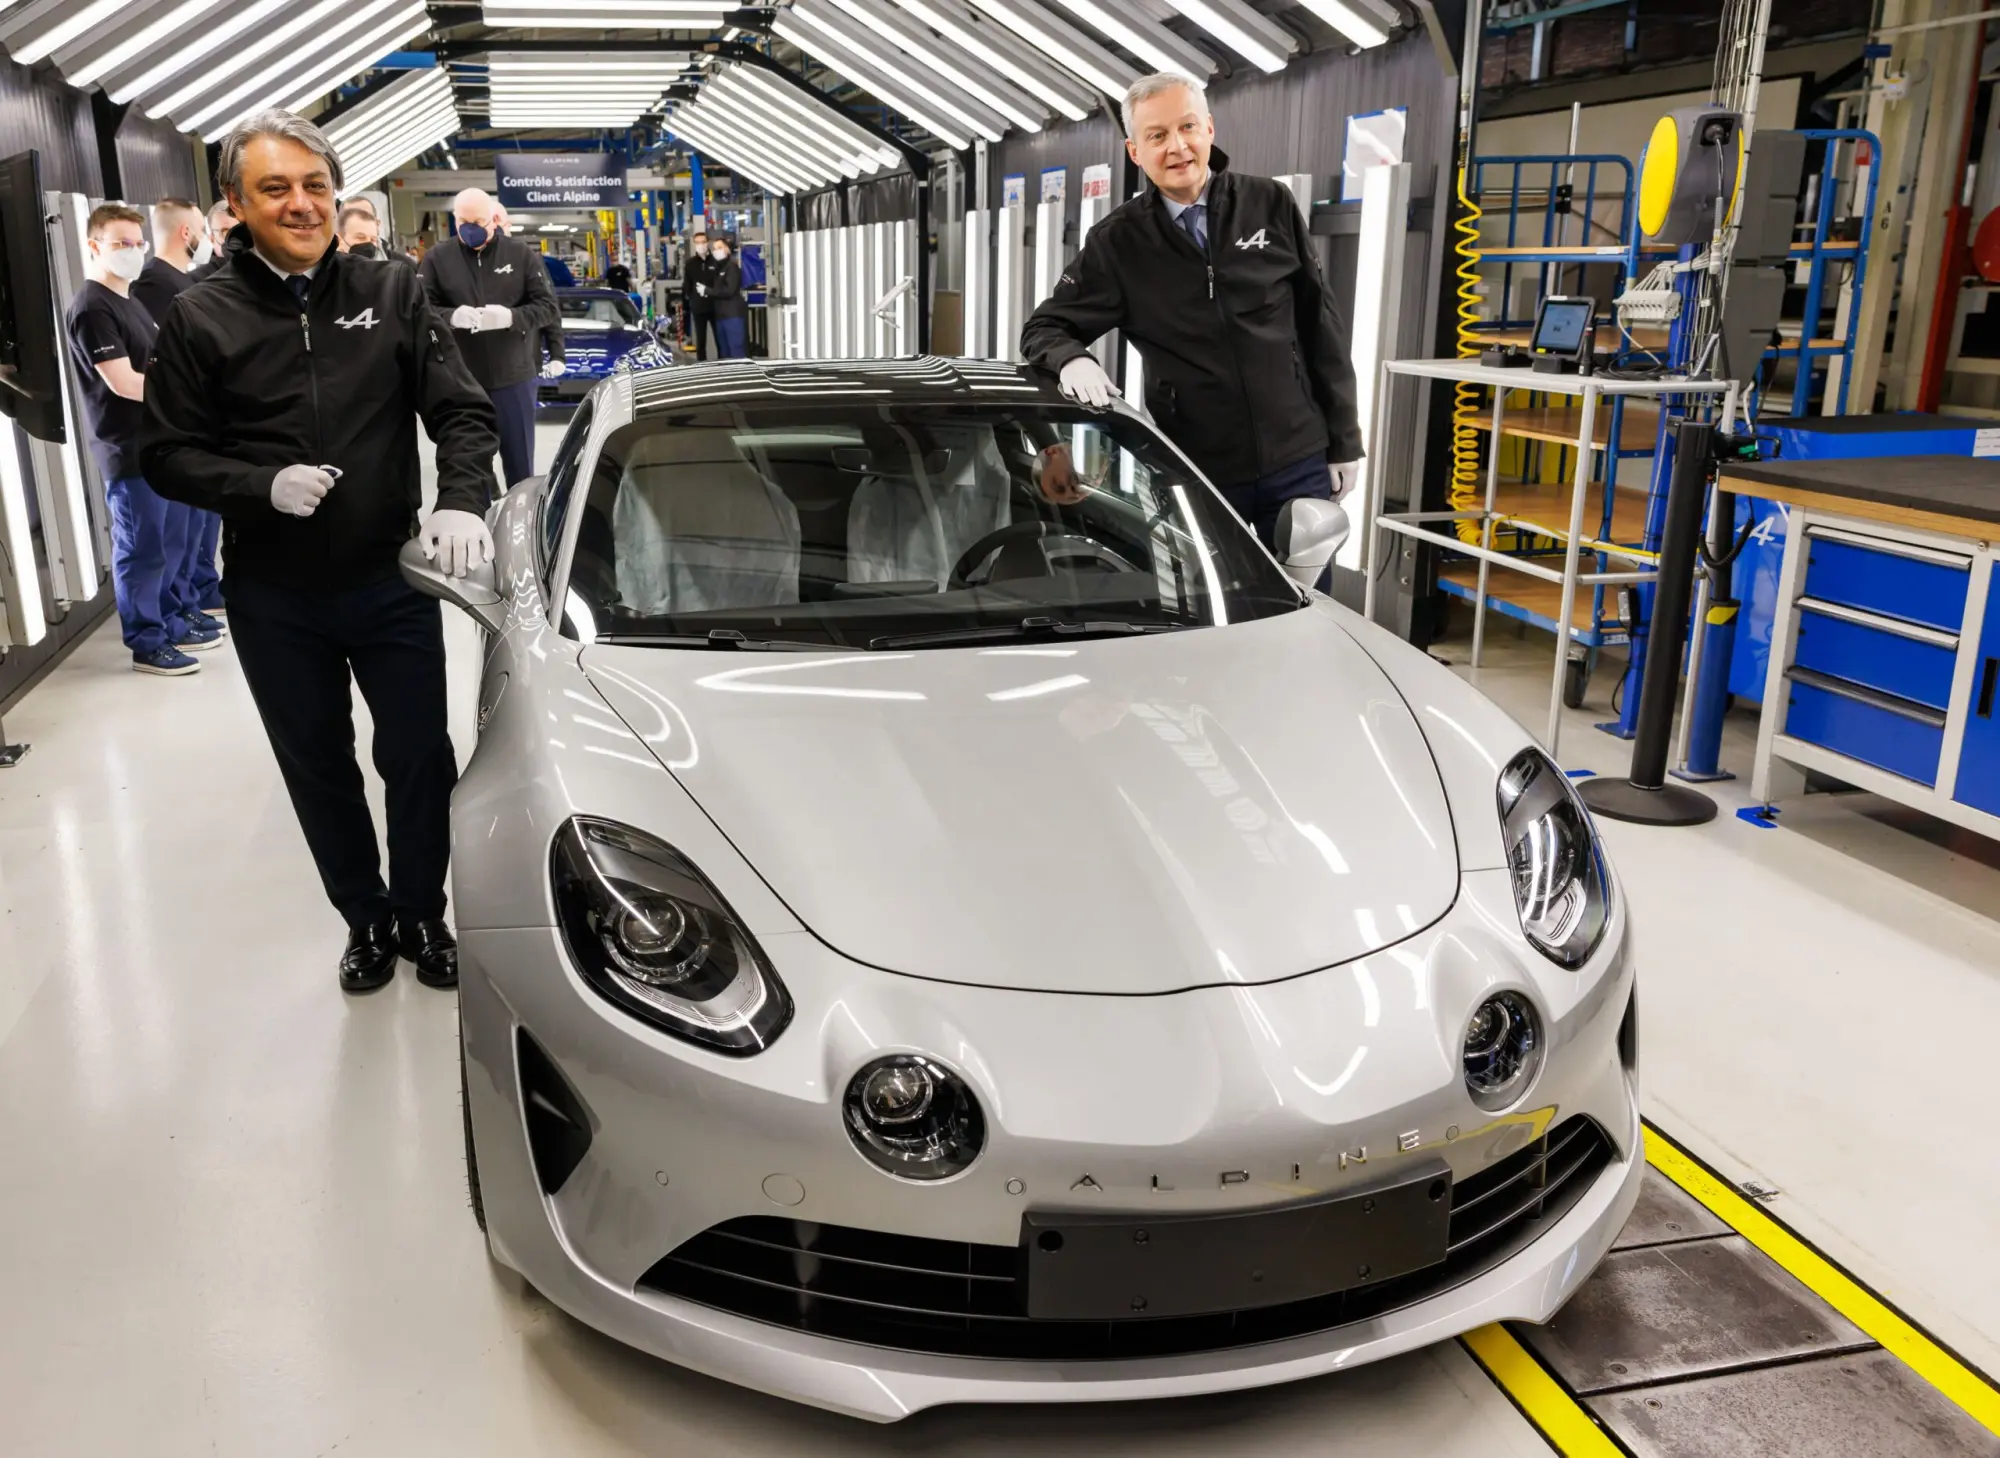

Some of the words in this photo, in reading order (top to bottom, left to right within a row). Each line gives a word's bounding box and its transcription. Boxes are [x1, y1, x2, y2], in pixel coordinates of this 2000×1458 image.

[502, 176, 553, 188] Contrôle
[555, 175, 622, 188] Satisfaction
[526, 191, 561, 203] Client
[563, 190, 601, 204] Alpine
[1070, 1128, 1420, 1192] ALPINE
